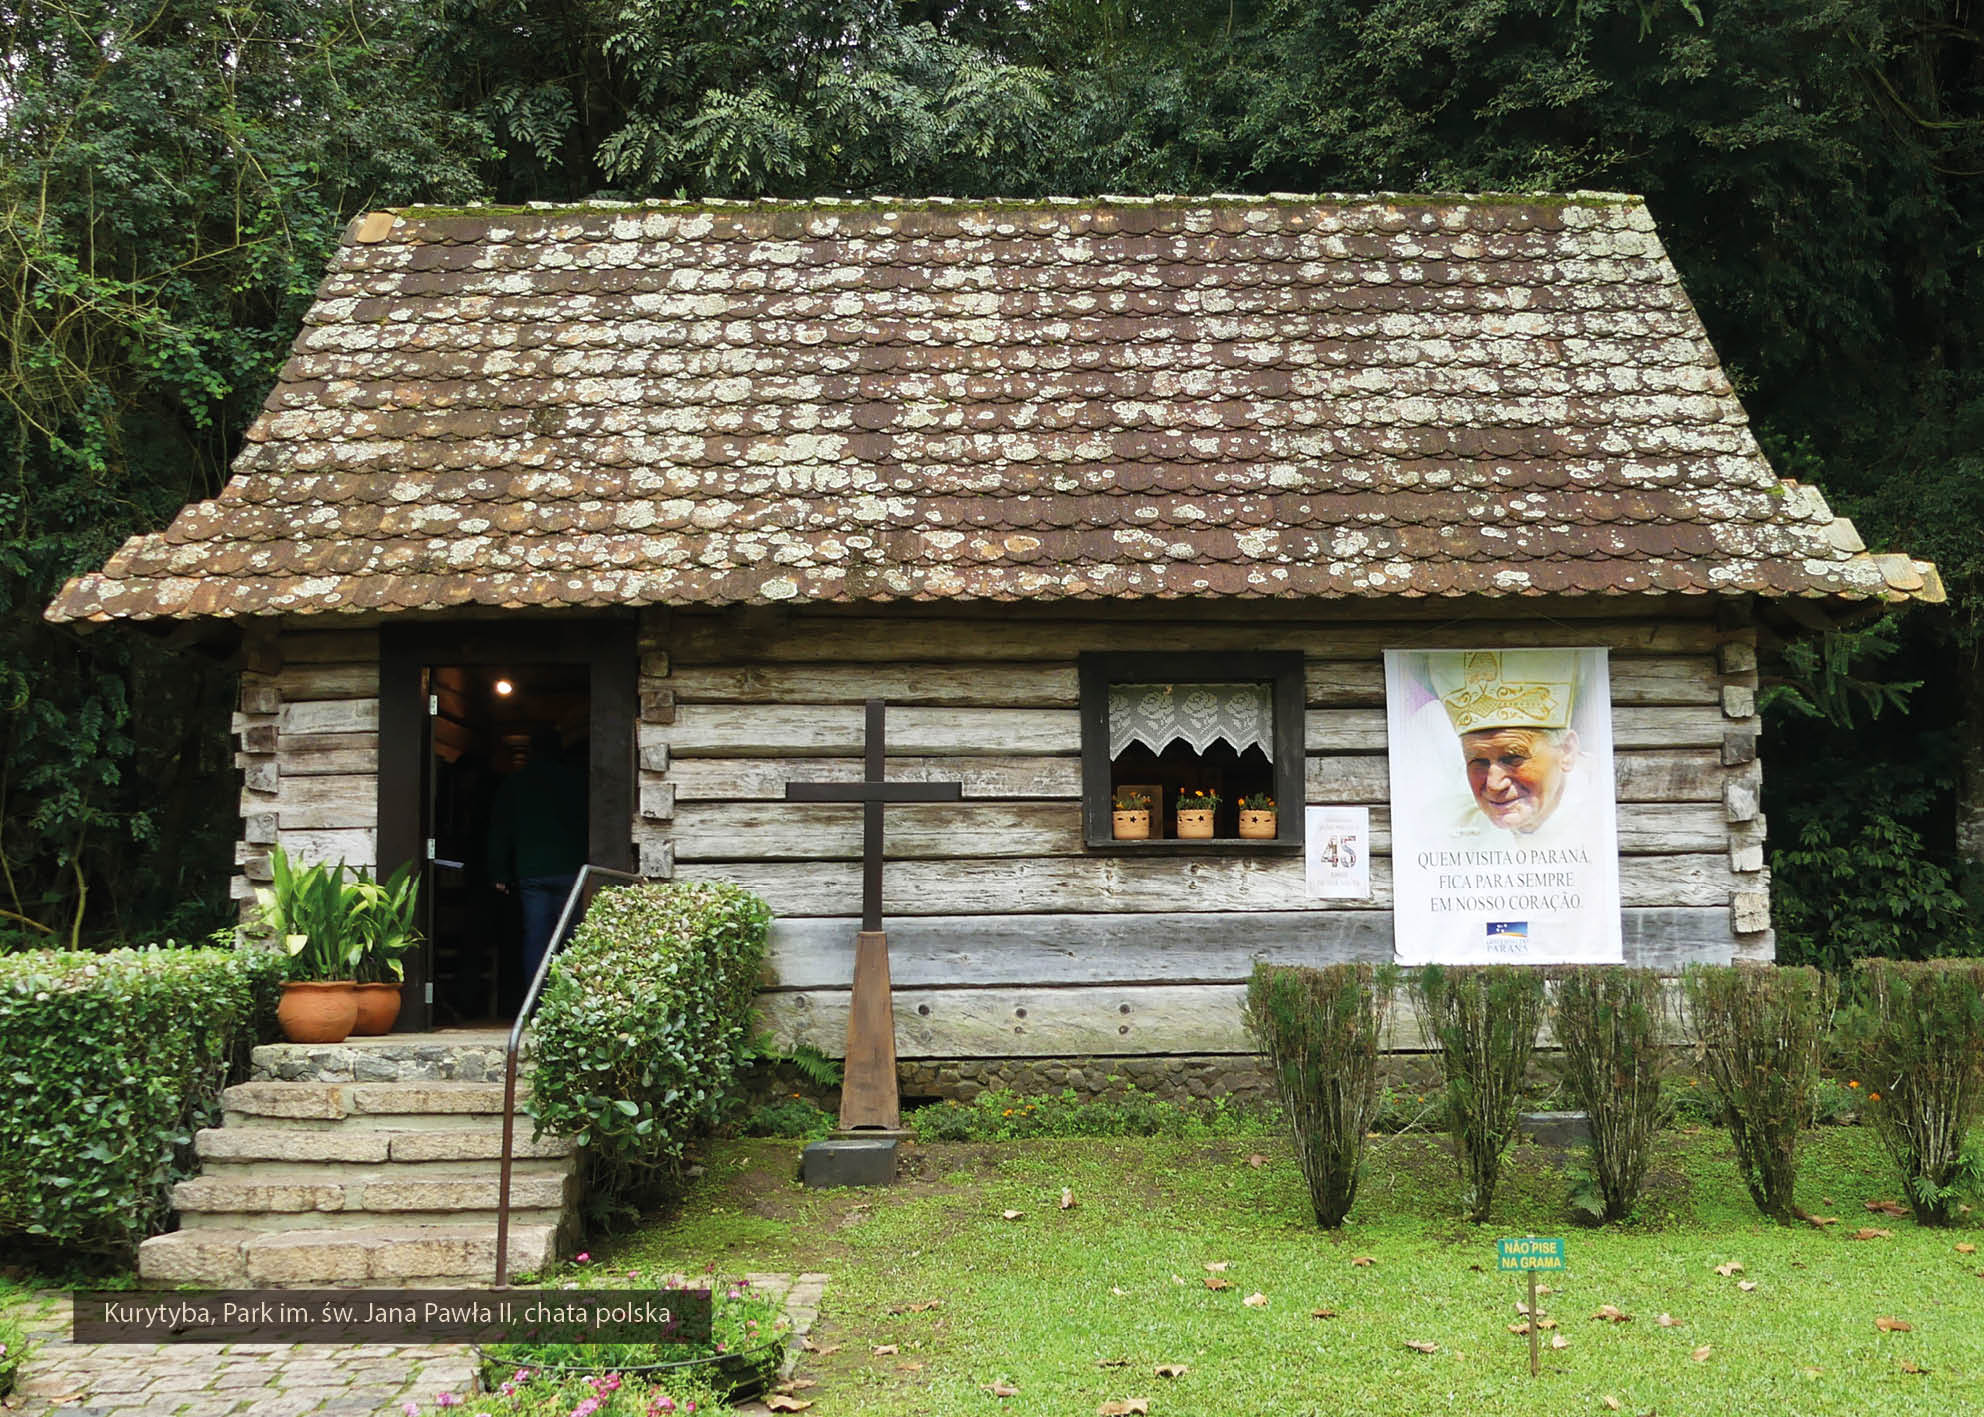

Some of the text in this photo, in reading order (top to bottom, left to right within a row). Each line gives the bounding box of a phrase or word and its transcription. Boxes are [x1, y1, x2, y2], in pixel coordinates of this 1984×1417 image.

[1321, 834, 1357, 868] 45
[1417, 851, 1462, 870] QUEM
[1465, 850, 1513, 866] VISITA
[1516, 850, 1527, 865] O
[1439, 872, 1576, 889] FICA PARA SEMPRE
[1430, 897, 1453, 912] EM
[1456, 896, 1506, 912] NOSSO
[1504, 1240, 1557, 1254] NÃO PISE
[1502, 1256, 1562, 1269] NA GRAMA
